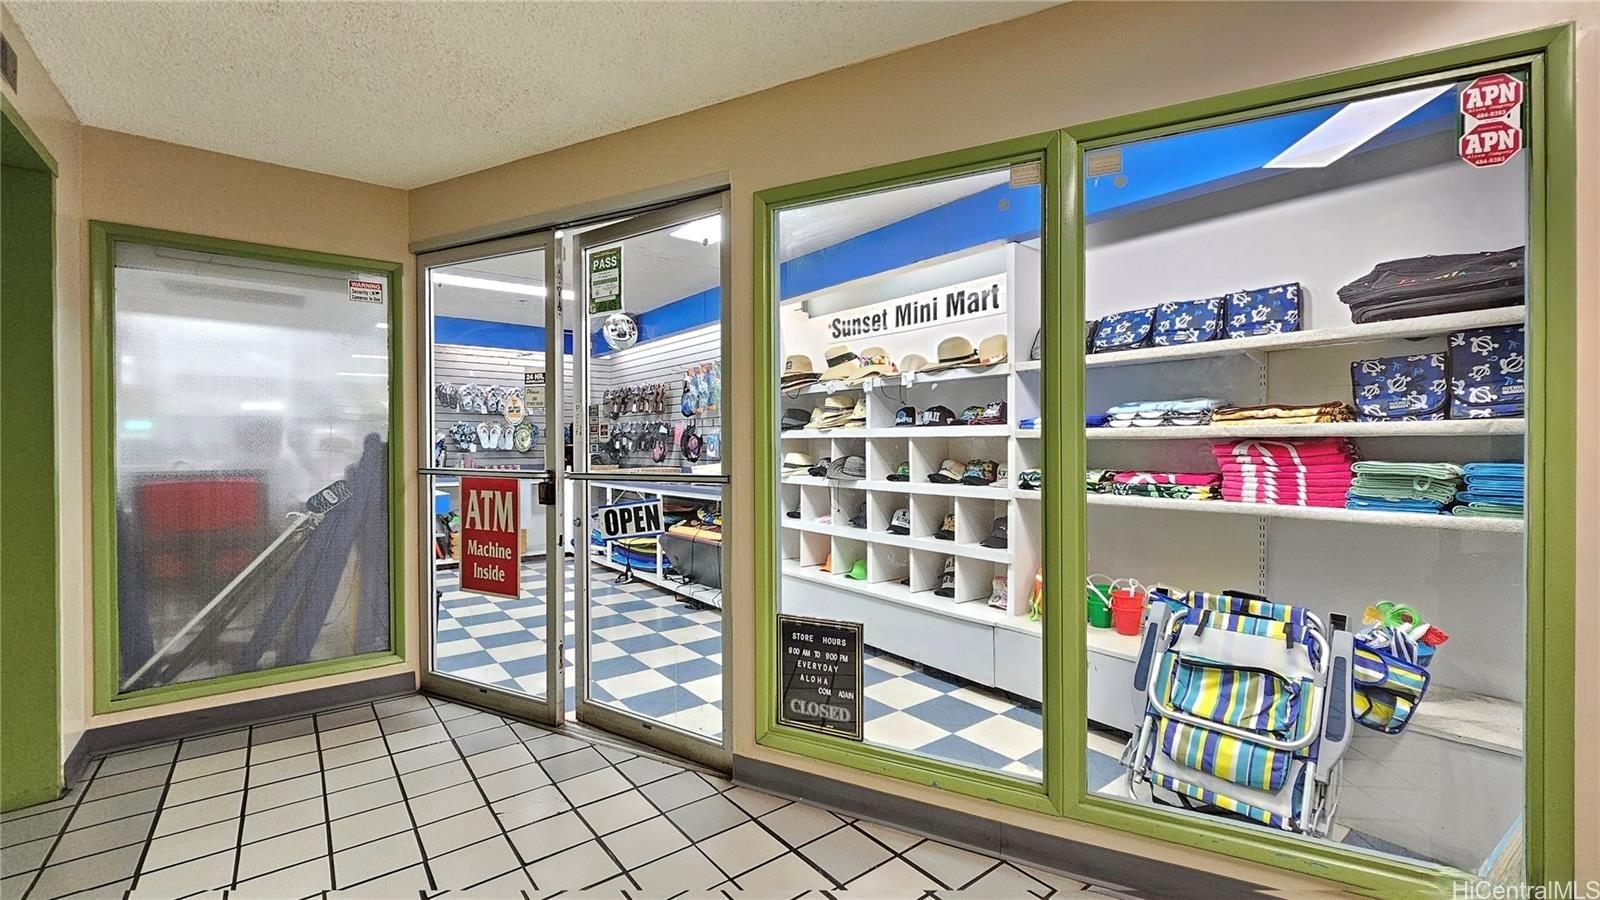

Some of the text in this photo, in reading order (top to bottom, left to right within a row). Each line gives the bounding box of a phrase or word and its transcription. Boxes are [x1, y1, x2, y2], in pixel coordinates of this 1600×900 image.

[1466, 82, 1517, 109] APN
[1465, 129, 1516, 155] APN
[593, 255, 617, 271] PASS
[351, 282, 380, 290] WARNING
[831, 284, 999, 339] Sunset Mini Mart
[465, 489, 515, 533] ATM
[604, 504, 661, 536] OPEN
[467, 539, 512, 560] Machine
[473, 562, 505, 582] Inside
[792, 632, 847, 647] STORE HOURS
[797, 659, 839, 673] EVERYDAY
[802, 649, 811, 657] AM
[814, 650, 821, 659] TO
[839, 654, 849, 663] PM
[800, 673, 829, 686] ALOHA
[838, 690, 855, 701] AGAIN
[790, 699, 851, 721] CLOSED
